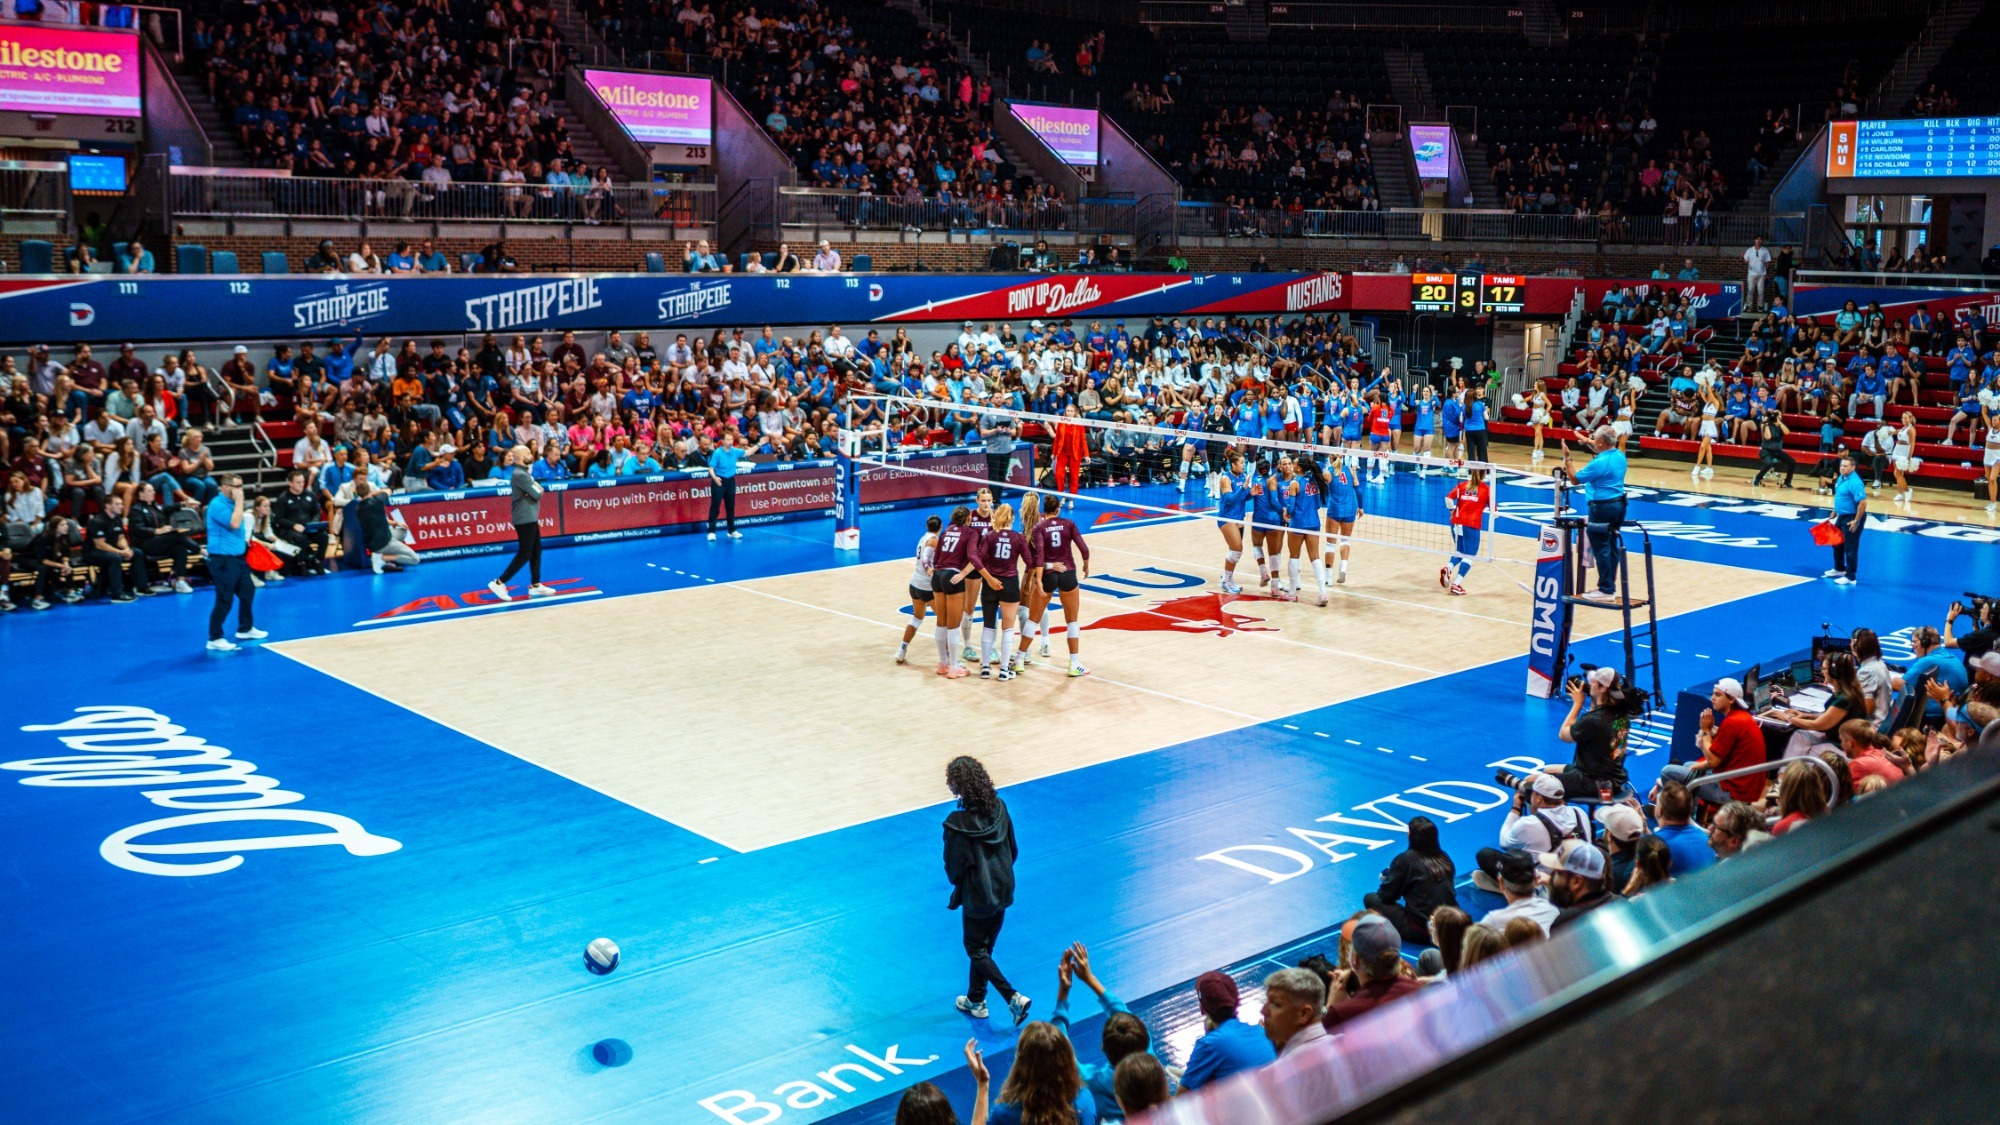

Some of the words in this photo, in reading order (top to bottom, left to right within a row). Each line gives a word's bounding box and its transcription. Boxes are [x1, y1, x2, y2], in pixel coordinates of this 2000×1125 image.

[0, 40, 122, 72] ilestone
[598, 85, 700, 110] Milestone
[105, 119, 136, 133] 212
[1861, 121, 1886, 130] PLAYER
[1924, 119, 1939, 128] KILL
[1946, 119, 1960, 127] BLK
[1967, 118, 1981, 126] DIG
[685, 147, 706, 159] 213
[230, 282, 250, 294] 112
[690, 281, 701, 291] THE
[776, 278, 790, 288] 112
[845, 278, 859, 288] 113
[1232, 276, 1241, 285] 114
[1461, 277, 1476, 286] SET
[1493, 276, 1515, 284] TAMU
[119, 283, 138, 294] 111
[335, 285, 348, 296] THE
[1008, 286, 1035, 314] PONY
[1036, 283, 1050, 304] UP
[1046, 276, 1101, 314] Dallas
[1286, 275, 1342, 311] MUSTANGS
[1421, 285, 1446, 300] 20
[1491, 286, 1516, 302] 17
[1724, 285, 1737, 294] 115
[465, 278, 602, 331] STAMPEDE
[658, 283, 732, 320] STAMPEDE
[1461, 291, 1475, 307] 3
[293, 287, 389, 328] STAMPEDE
[873, 471, 887, 480] our
[930, 464, 950, 474] SMU
[952, 462, 987, 474] package.
[1339, 472, 1348, 485] 4
[574, 498, 602, 510] Pony
[605, 497, 620, 508] up
[622, 492, 646, 505] with
[648, 490, 676, 503] Pride
[679, 488, 688, 499] in
[691, 487, 712, 498] Dall
[735, 482, 766, 494] arriott
[768, 477, 820, 491] Downtown
[836, 464, 845, 520] SMU
[751, 498, 769, 509] Use
[771, 495, 803, 507] Promo
[805, 492, 829, 503] Code
[418, 510, 488, 526] MARRIOTT
[418, 525, 472, 540] DALLAS
[476, 517, 554, 535] DOWNWN
[624, 529, 645, 537] Medical
[941, 536, 960, 552] 37
[1051, 531, 1062, 547] 9
[994, 542, 1011, 559] 16
[1531, 575, 1559, 657] SMU
[0, 706, 403, 876] Dallas
[1195, 780, 1510, 885] DAVID
